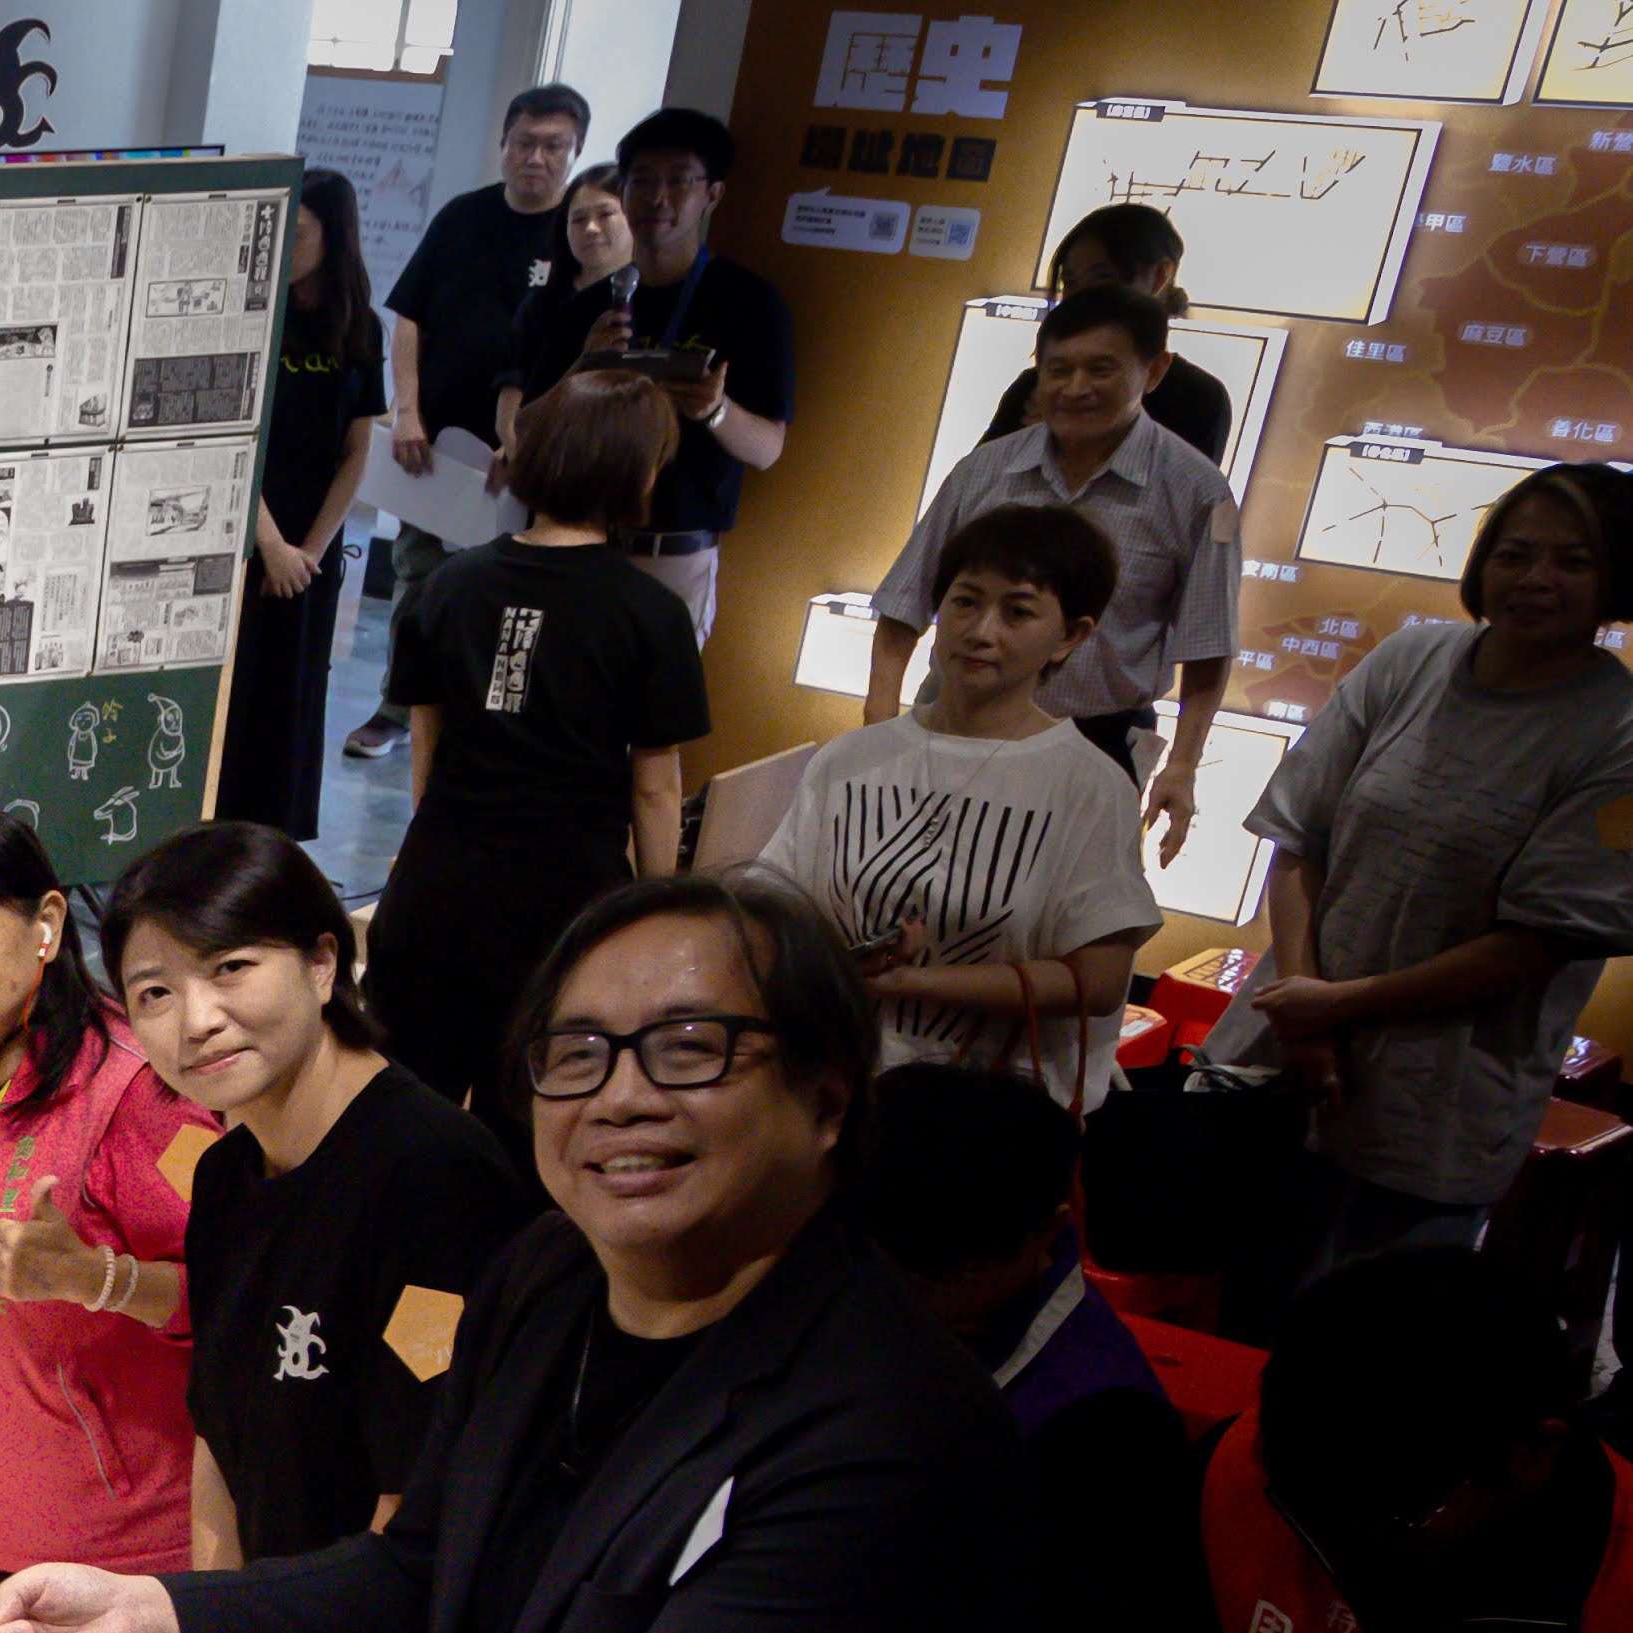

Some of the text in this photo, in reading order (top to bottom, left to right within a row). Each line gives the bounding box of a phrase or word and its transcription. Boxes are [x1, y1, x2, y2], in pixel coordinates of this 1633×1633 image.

[1488, 153, 1557, 176] 鹽水區
[1526, 244, 1590, 267] 下營區
[1461, 324, 1527, 347] 麻豆區
[1346, 340, 1408, 362] 佳里區
[1551, 419, 1617, 443] 善化區
[1318, 616, 1360, 638] 北區
[1281, 636, 1342, 660] 中西區
